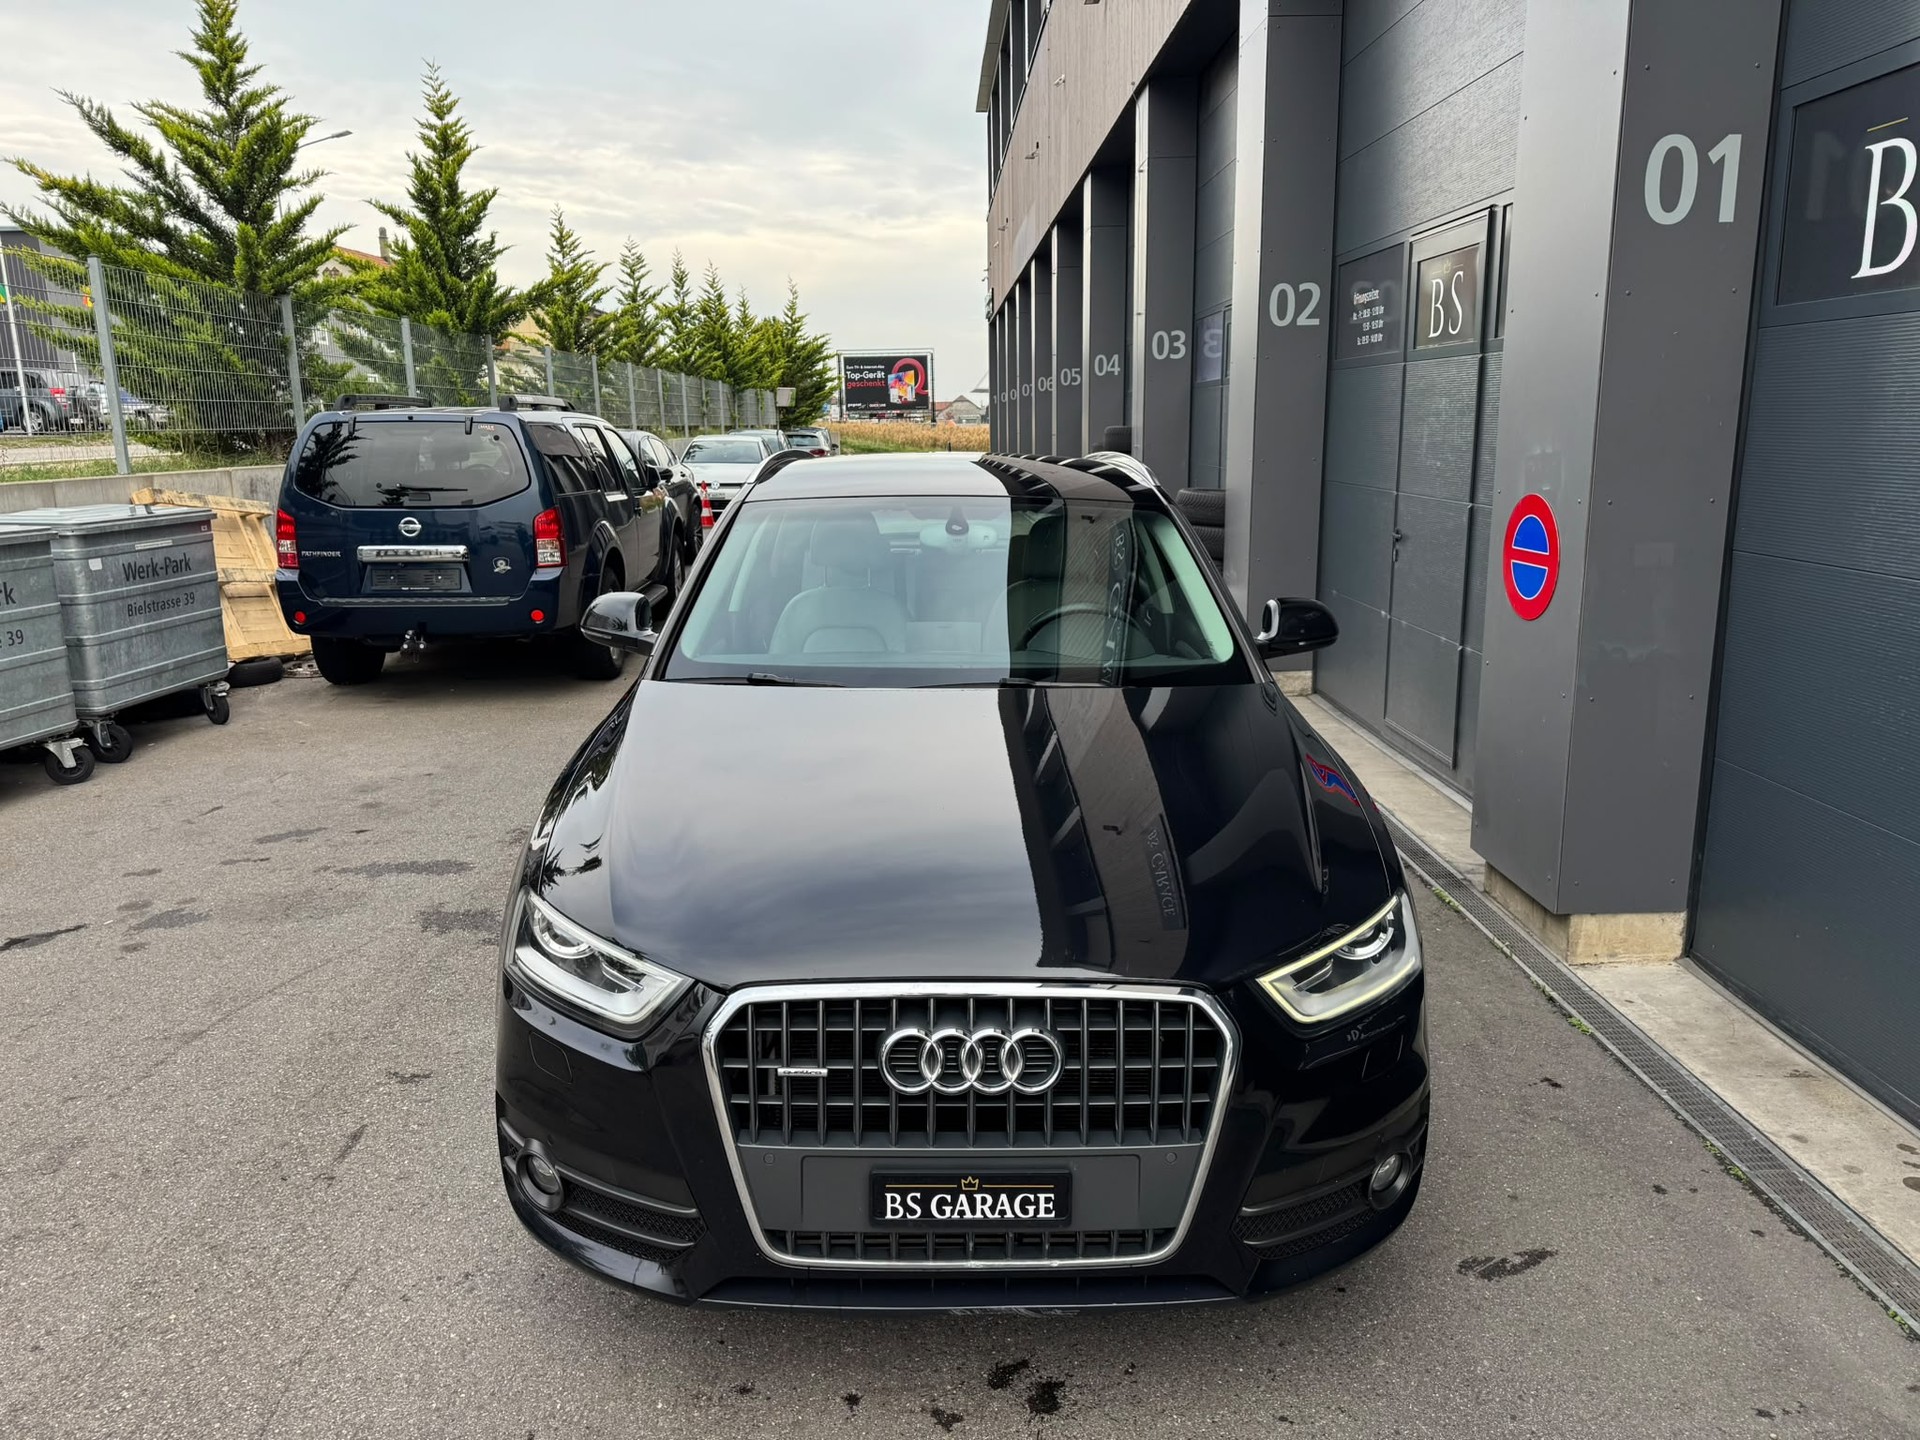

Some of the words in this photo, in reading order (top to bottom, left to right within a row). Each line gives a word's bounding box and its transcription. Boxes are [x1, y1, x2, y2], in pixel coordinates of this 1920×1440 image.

[1644, 133, 1742, 226] 01
[1268, 282, 1321, 328] 02
[1427, 270, 1465, 339] BS
[1151, 329, 1187, 361] 03
[846, 370, 886, 380] Top-Gerät
[1060, 367, 1081, 386] 05
[1094, 354, 1121, 377] 04
[846, 379, 886, 389] geschenkt
[1038, 376, 1055, 392] 06
[301, 550, 341, 558] PATHFINDER
[122, 552, 192, 582] Werk-Park
[127, 595, 182, 618] Bielstrasse
[184, 591, 196, 607] 39
[6, 629, 24, 647] 39
[885, 1192, 922, 1220] BS
[930, 1192, 1056, 1220] GARAGE
